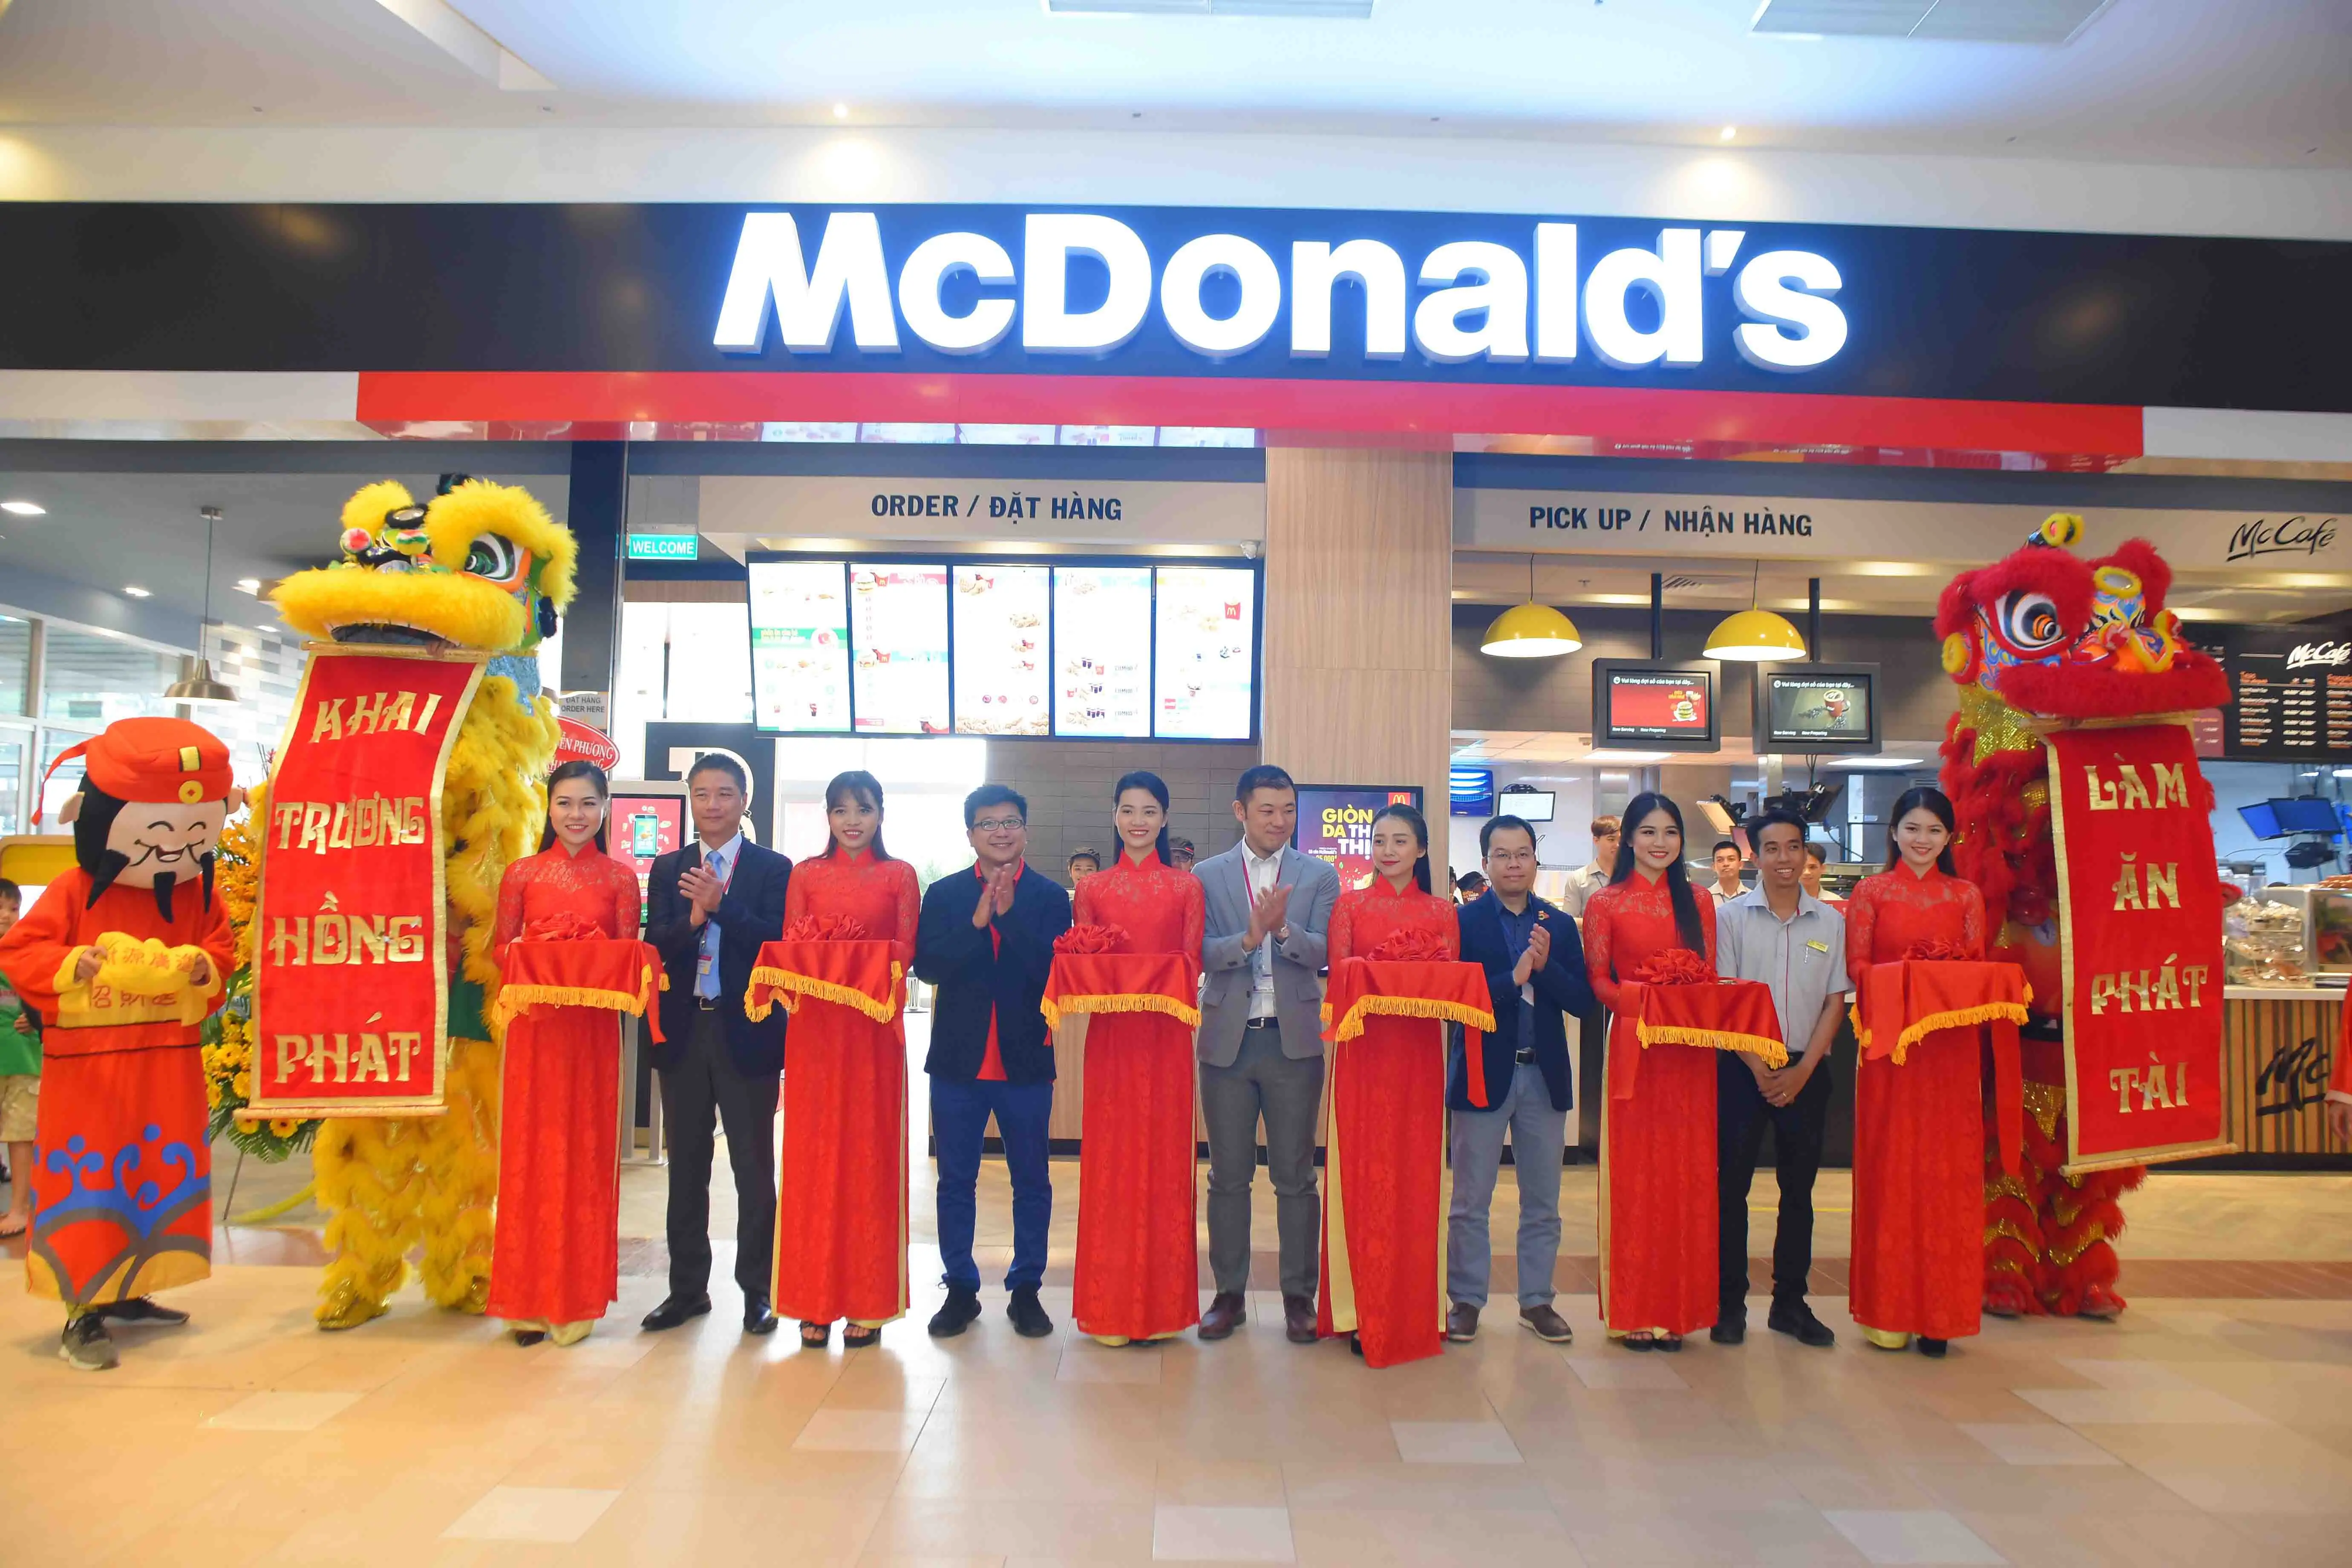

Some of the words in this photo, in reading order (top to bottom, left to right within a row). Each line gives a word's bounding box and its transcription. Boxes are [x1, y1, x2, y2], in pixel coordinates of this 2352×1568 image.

[712, 211, 1848, 373] McDonald's
[872, 494, 959, 517] ORDER
[989, 492, 1041, 524] ĐẶT
[1051, 491, 1121, 521] HÀNG
[1530, 507, 1588, 530] PICK
[1598, 509, 1631, 530] UP
[1665, 505, 1734, 537] NHẬN
[1744, 507, 1812, 536] HÀNG
[633, 540, 695, 554] WELCOME
[2226, 516, 2338, 562] McCafé
[2286, 641, 2352, 669] McCafé
[308, 691, 443, 743] KHAI
[2083, 752, 2190, 810] LÀM
[275, 791, 425, 855] TRƯƠNG
[1322, 804, 1373, 824] GIÒN
[1323, 824, 1346, 838] DA
[1337, 839, 1371, 860] THỊ
[2112, 852, 2181, 911] ĂN
[269, 891, 424, 966] HỒNG
[2091, 954, 2208, 1015] PHÁT
[274, 1012, 421, 1084] PHÁT
[2110, 1051, 2189, 1113] TÀI
